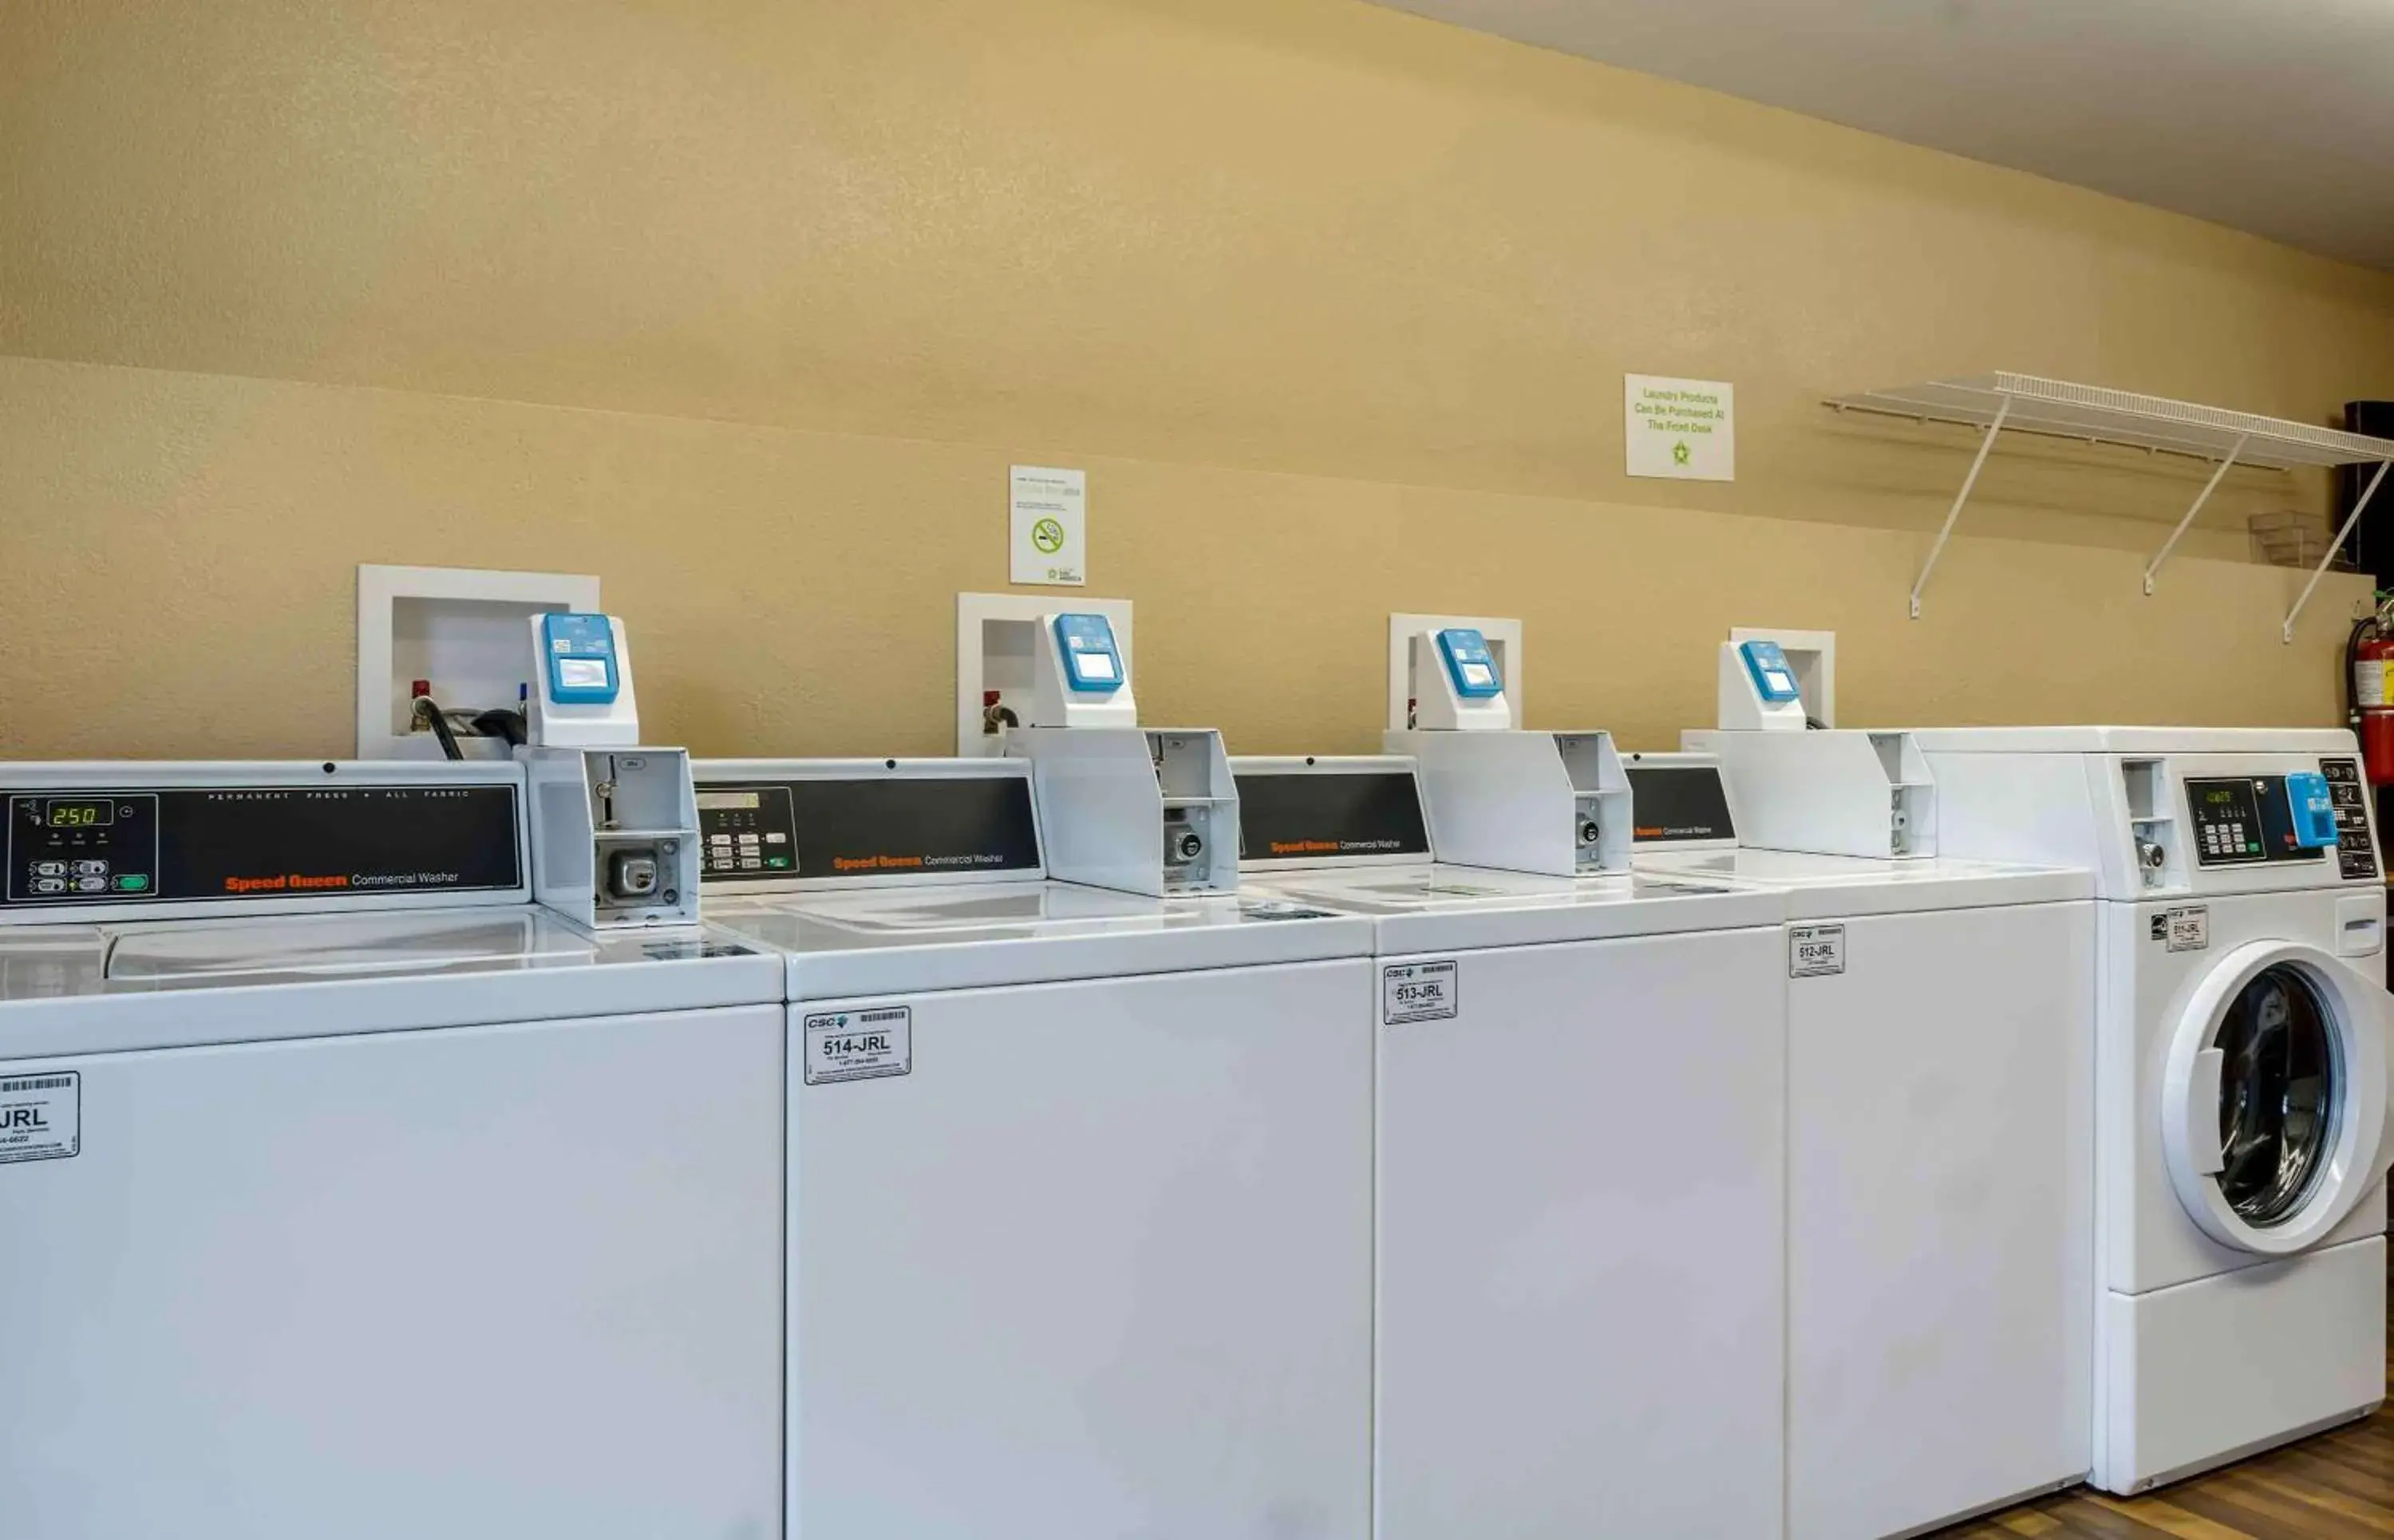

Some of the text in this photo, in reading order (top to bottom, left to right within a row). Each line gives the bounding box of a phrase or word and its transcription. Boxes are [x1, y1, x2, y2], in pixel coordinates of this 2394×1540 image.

[1635, 402, 1652, 413] Can
[1655, 405, 1665, 414] Be
[1669, 405, 1713, 418] Purchased
[1647, 419, 1663, 430] The
[1667, 421, 1689, 432] Front
[53, 808, 95, 824] 250
[834, 856, 876, 870] Speed
[879, 855, 922, 867] Queen
[925, 855, 972, 866] Commercial
[226, 871, 458, 891] Speed Queen Commercial Washer
[1799, 944, 1835, 958] 512-JRL
[1396, 985, 1443, 999] 513-JRL
[808, 1018, 835, 1028] CSC
[823, 1036, 891, 1055] 514-JRL
[0, 1109, 48, 1128] JRL
